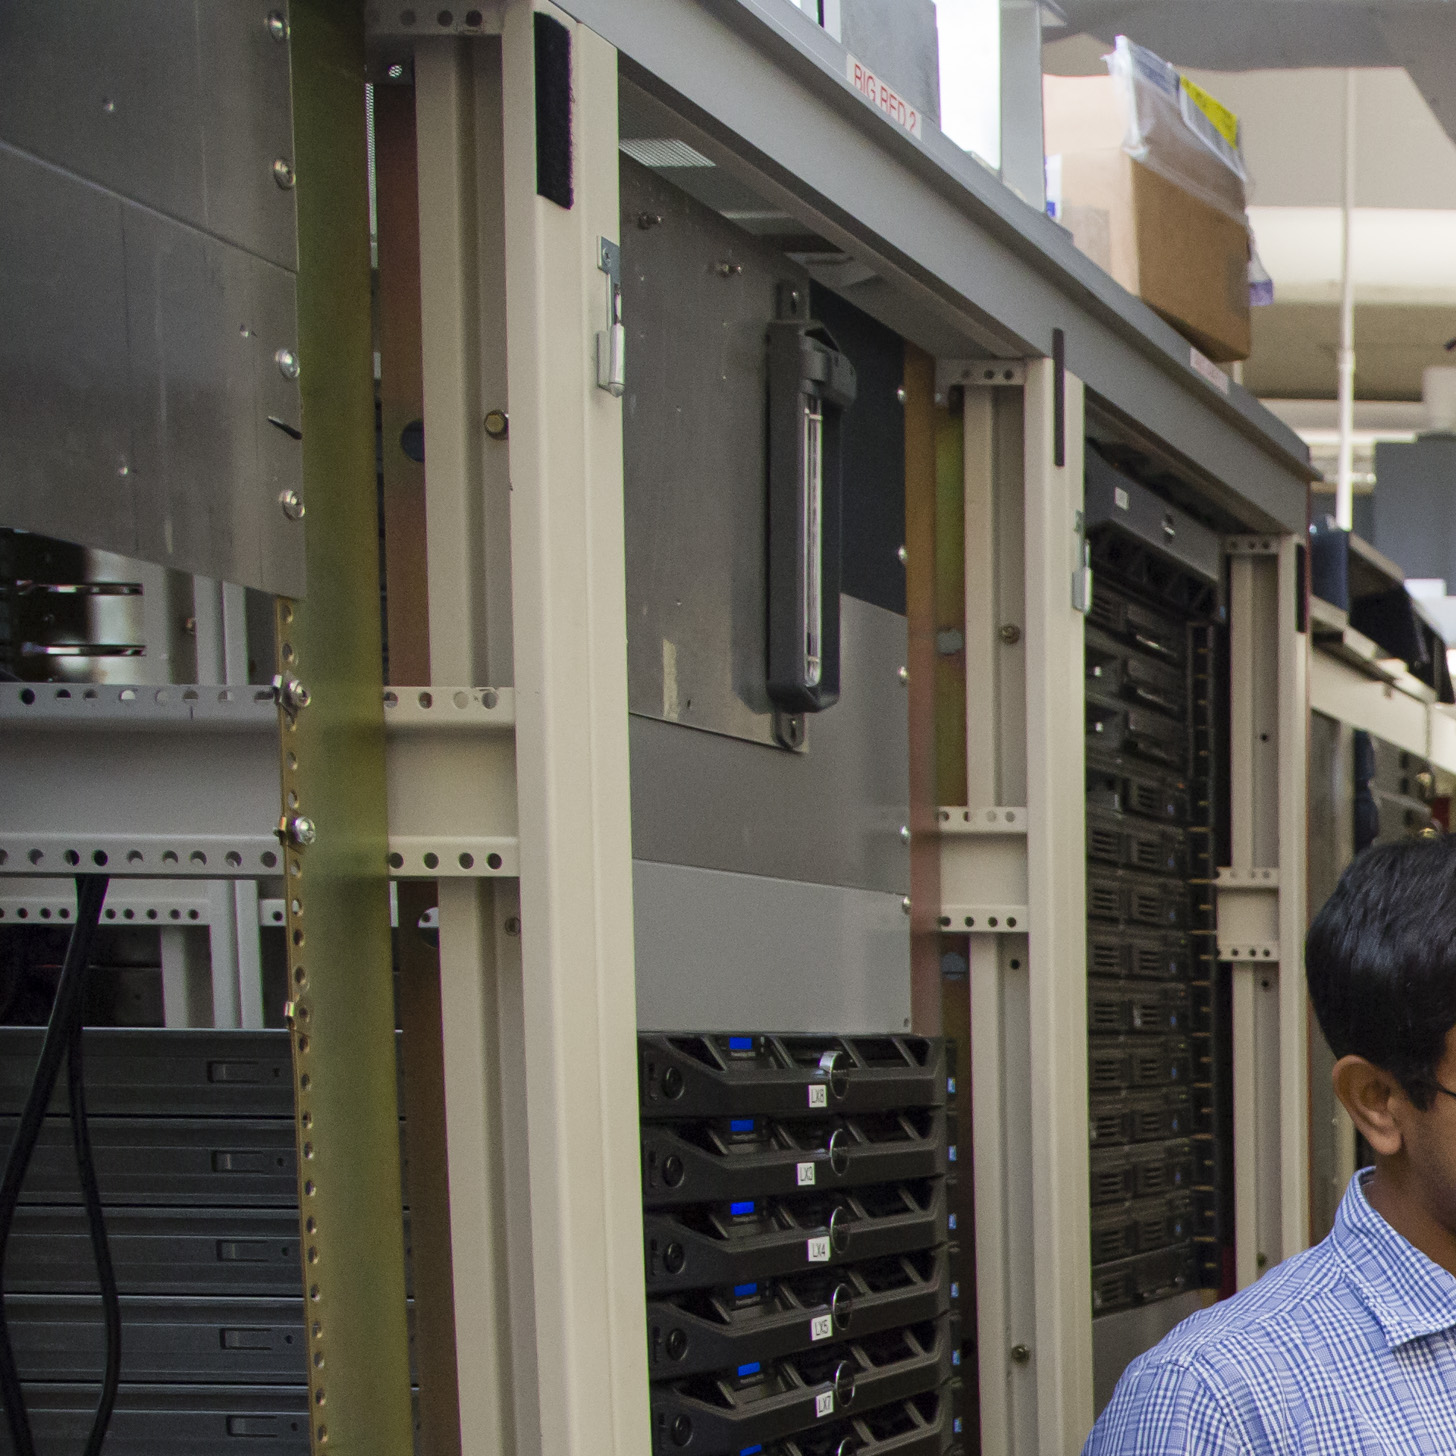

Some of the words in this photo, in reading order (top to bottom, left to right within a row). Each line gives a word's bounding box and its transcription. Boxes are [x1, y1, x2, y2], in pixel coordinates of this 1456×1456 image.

[853, 63, 876, 102] BIG
[880, 86, 907, 128] RED
[909, 111, 917, 132] 2
[811, 1243, 825, 1258] LX4
[814, 1319, 828, 1337] LX5
[818, 1395, 831, 1413] LX7
